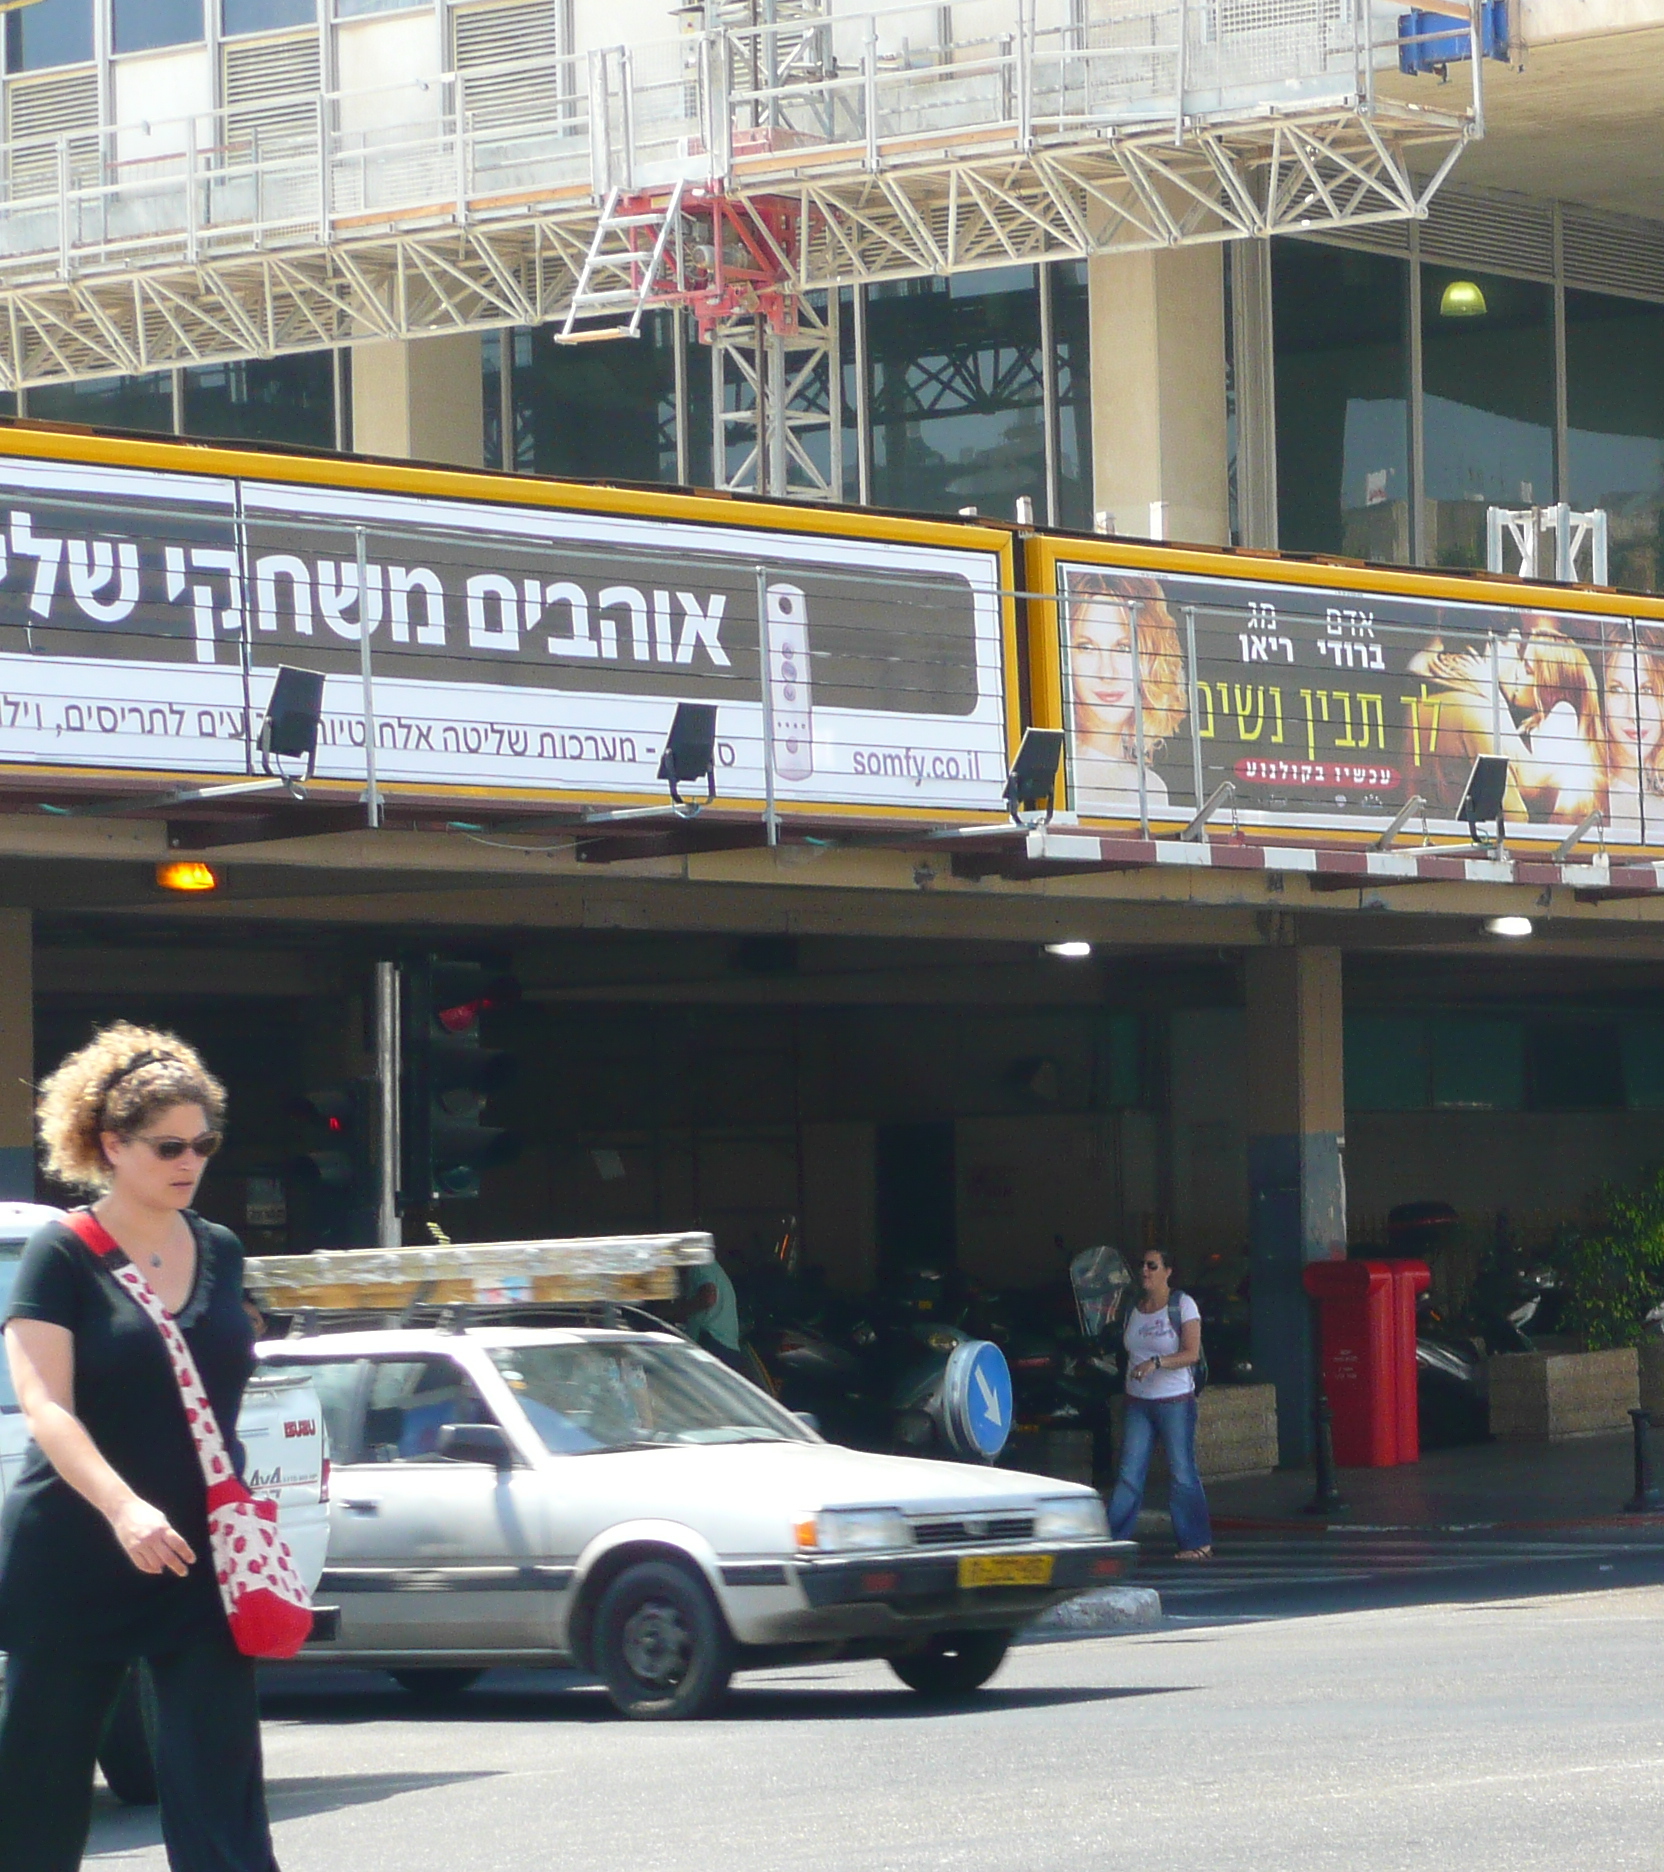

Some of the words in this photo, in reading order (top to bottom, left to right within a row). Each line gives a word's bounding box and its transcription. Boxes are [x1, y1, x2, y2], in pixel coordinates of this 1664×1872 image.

[165, 545, 446, 663] משחקי
[466, 573, 731, 667] אוהבים
[1248, 601, 1277, 630] מג
[1326, 607, 1374, 638] אדם
[1238, 633, 1294, 663] ריאן
[1316, 638, 1386, 670] ברודי
[0, 694, 42, 731] ויל
[55, 702, 186, 738] לתריסים,
[1192, 680, 1284, 744] נשים
[1300, 688, 1386, 761] תבין
[1400, 683, 1441, 767] לך
[443, 722, 529, 757] שליטה
[538, 731, 637, 764] מערכות
[852, 748, 982, 787] somfy.co.il
[1245, 760, 1325, 784] בקולנוע
[1334, 766, 1391, 785] עכשיו
